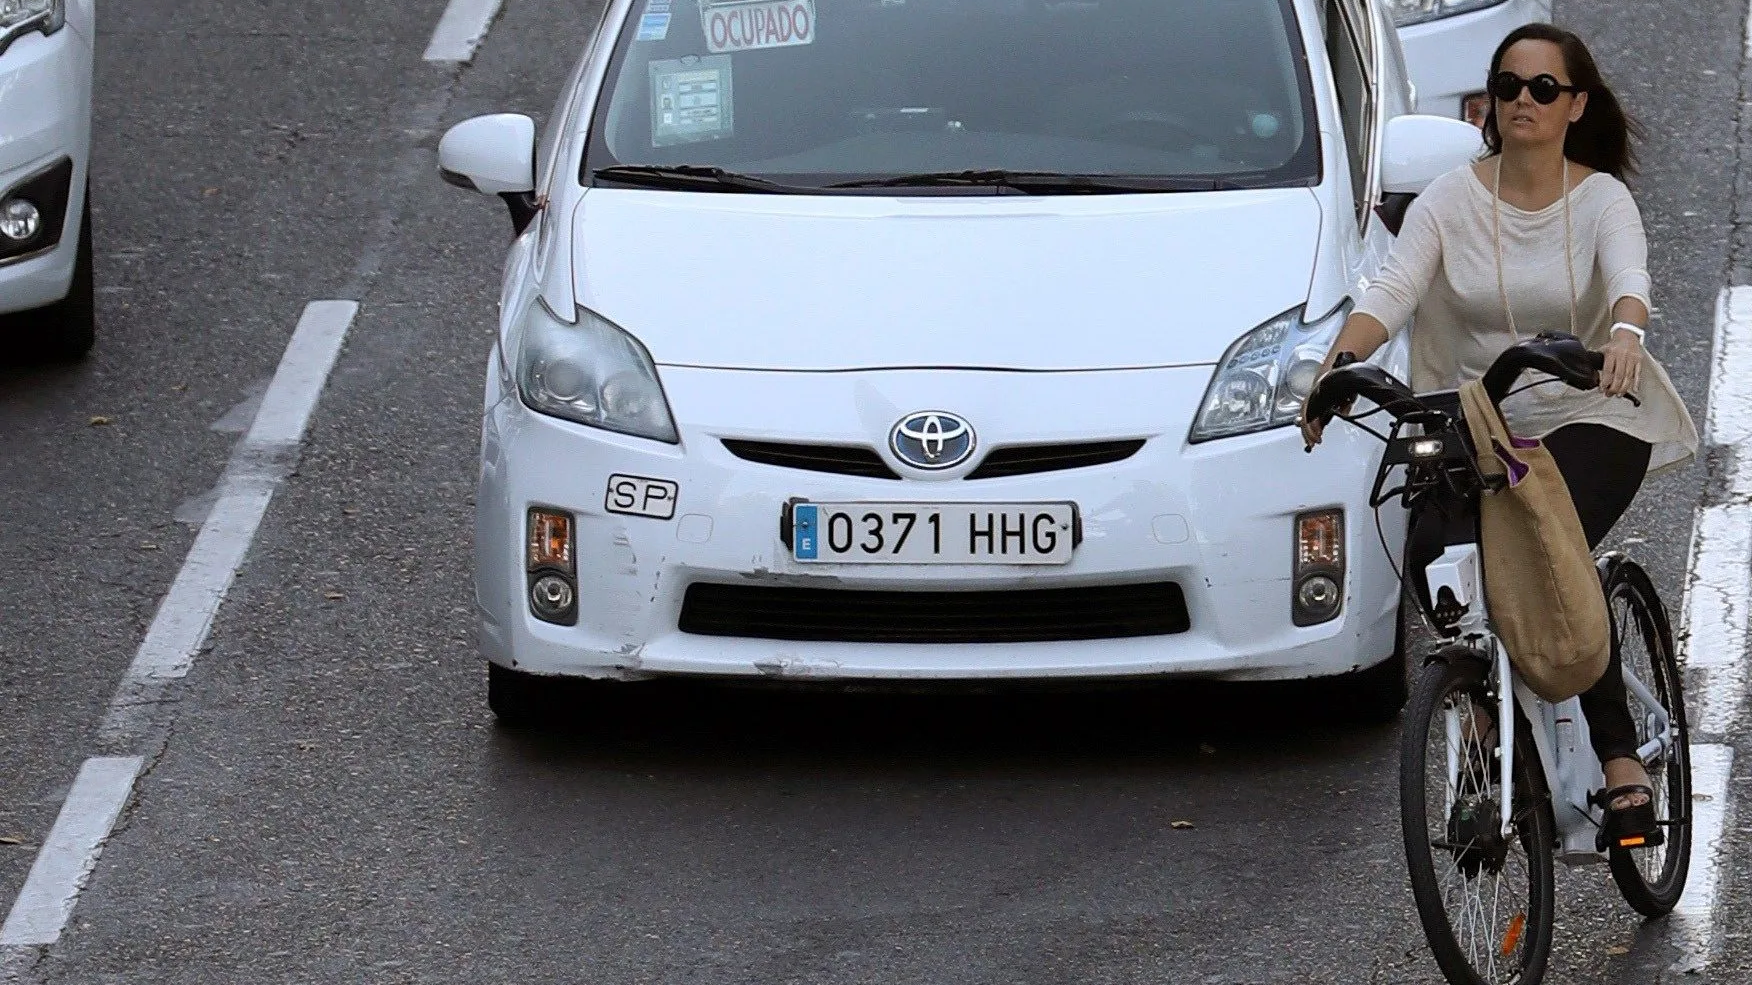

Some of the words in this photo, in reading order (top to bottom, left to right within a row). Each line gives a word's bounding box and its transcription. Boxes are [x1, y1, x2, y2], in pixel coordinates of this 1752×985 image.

[710, 4, 810, 49] OCUPADO
[613, 481, 670, 512] SP
[827, 512, 941, 554] 0371
[969, 512, 1057, 554] HHG
